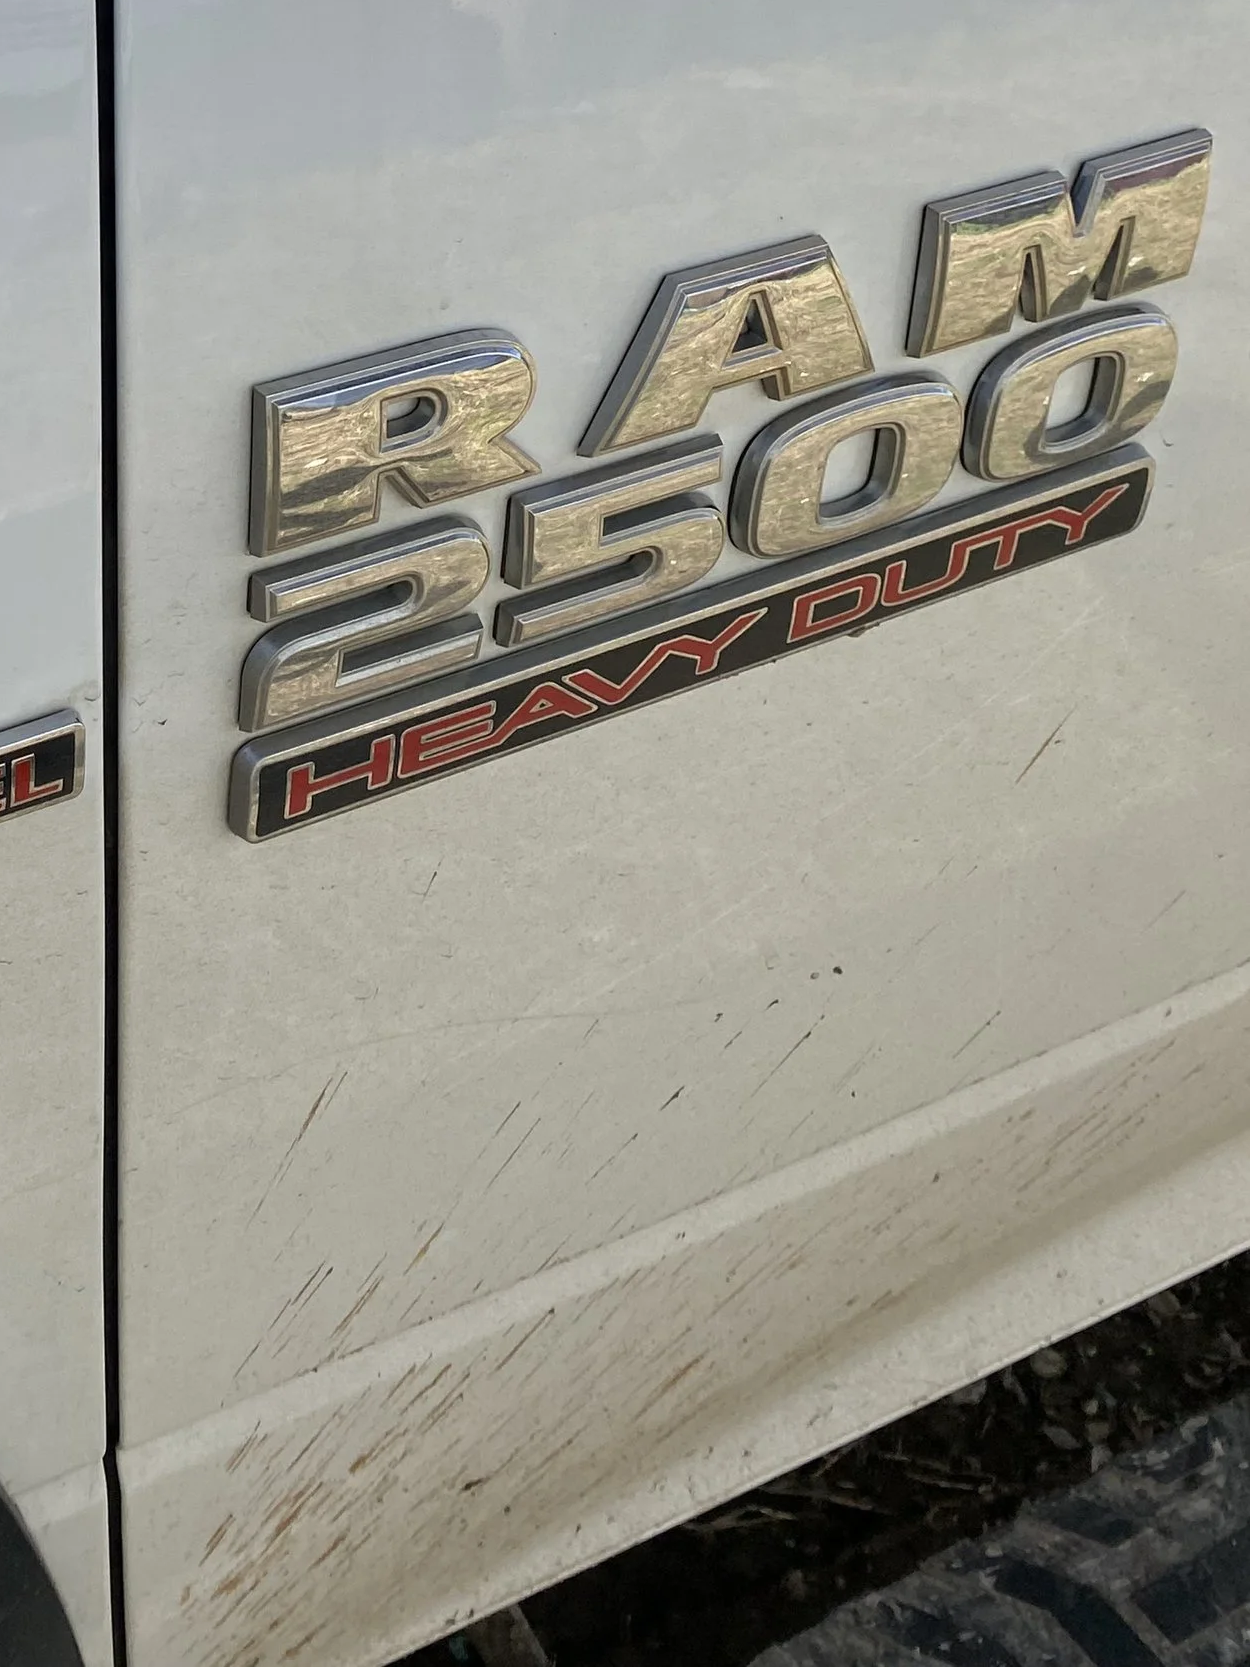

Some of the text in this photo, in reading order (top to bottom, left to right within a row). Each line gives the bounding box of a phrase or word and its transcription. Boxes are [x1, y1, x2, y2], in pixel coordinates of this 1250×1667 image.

[240, 302, 1179, 732] 2500
[250, 127, 1214, 555] RAM
[284, 483, 1122, 819] HEAVY DUTY
